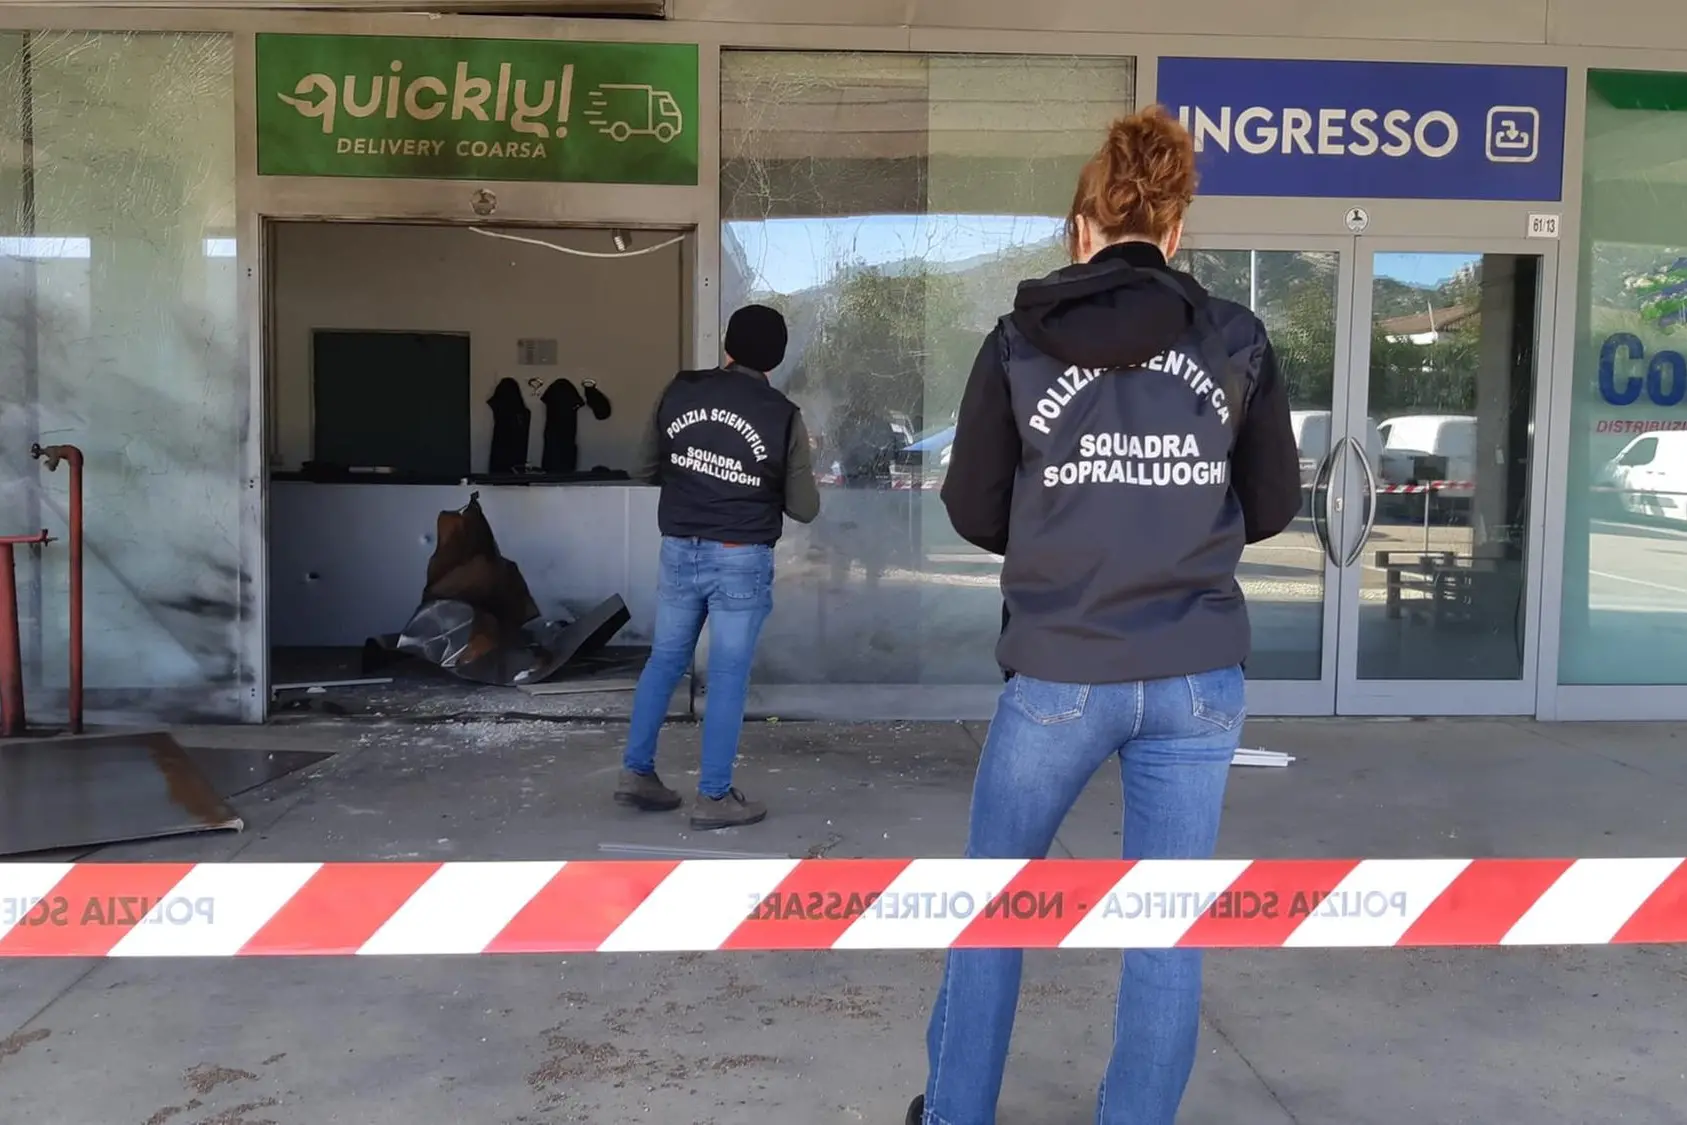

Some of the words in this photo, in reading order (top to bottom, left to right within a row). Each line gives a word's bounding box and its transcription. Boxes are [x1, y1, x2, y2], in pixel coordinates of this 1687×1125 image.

[277, 60, 574, 139] quickly!
[1179, 105, 1458, 158] INGRESSO
[337, 137, 445, 157] DELIVERY
[456, 140, 547, 159] COARSA
[666, 408, 707, 439] POLIZIA
[710, 407, 768, 462] SCIENTIFICA
[1080, 432, 1200, 459] SQUADRA
[670, 453, 761, 487] SOPRALLUOGHI
[687, 446, 743, 472] SQUADRA
[1043, 460, 1226, 487] SOPRALLUOGHI
